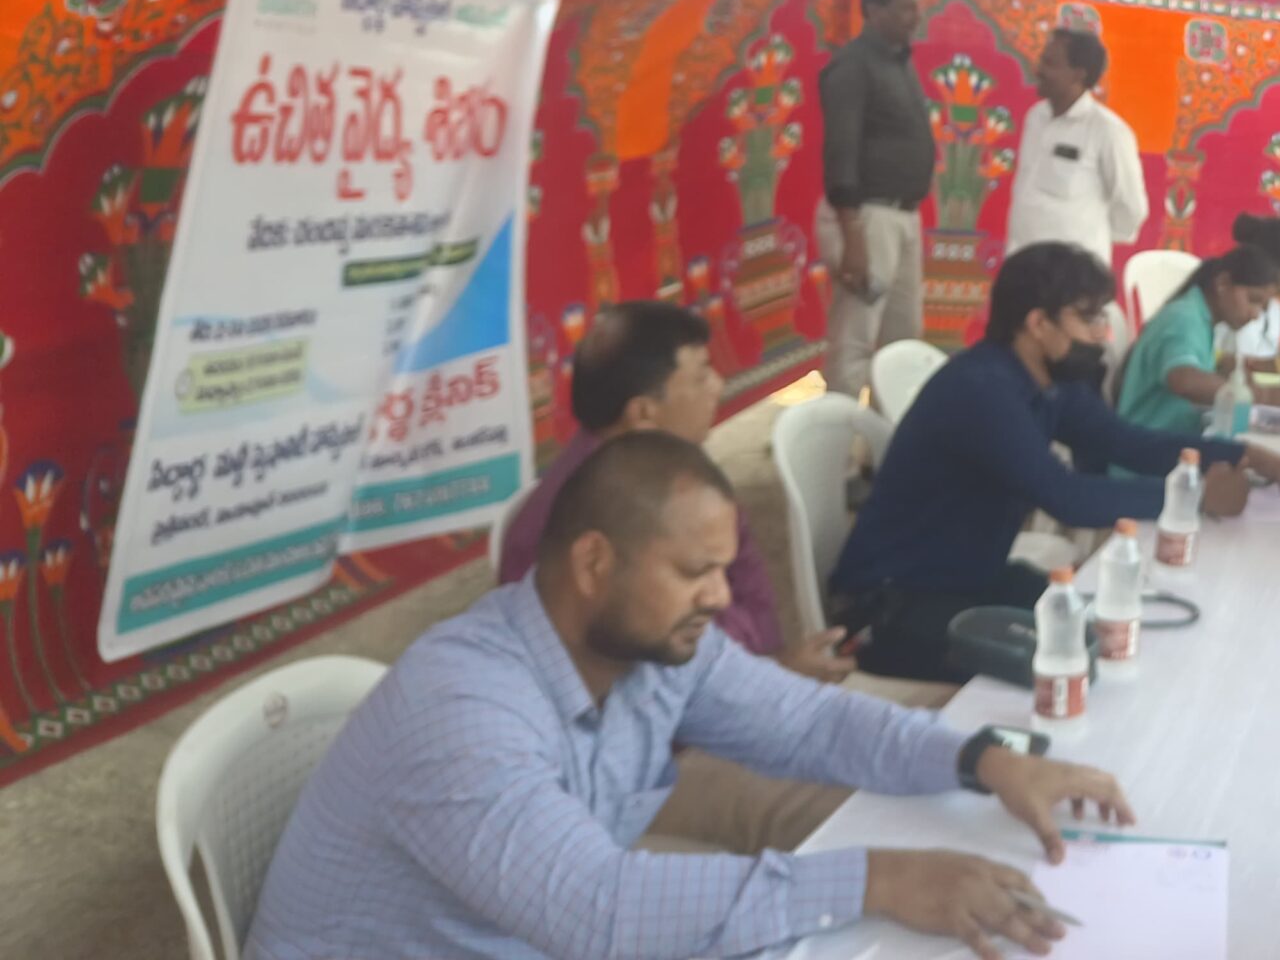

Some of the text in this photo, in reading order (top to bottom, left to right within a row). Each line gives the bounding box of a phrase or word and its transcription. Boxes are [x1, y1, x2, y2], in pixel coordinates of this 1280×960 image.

[231, 52, 509, 202] ఉచిత వైద్య శిబిరం
